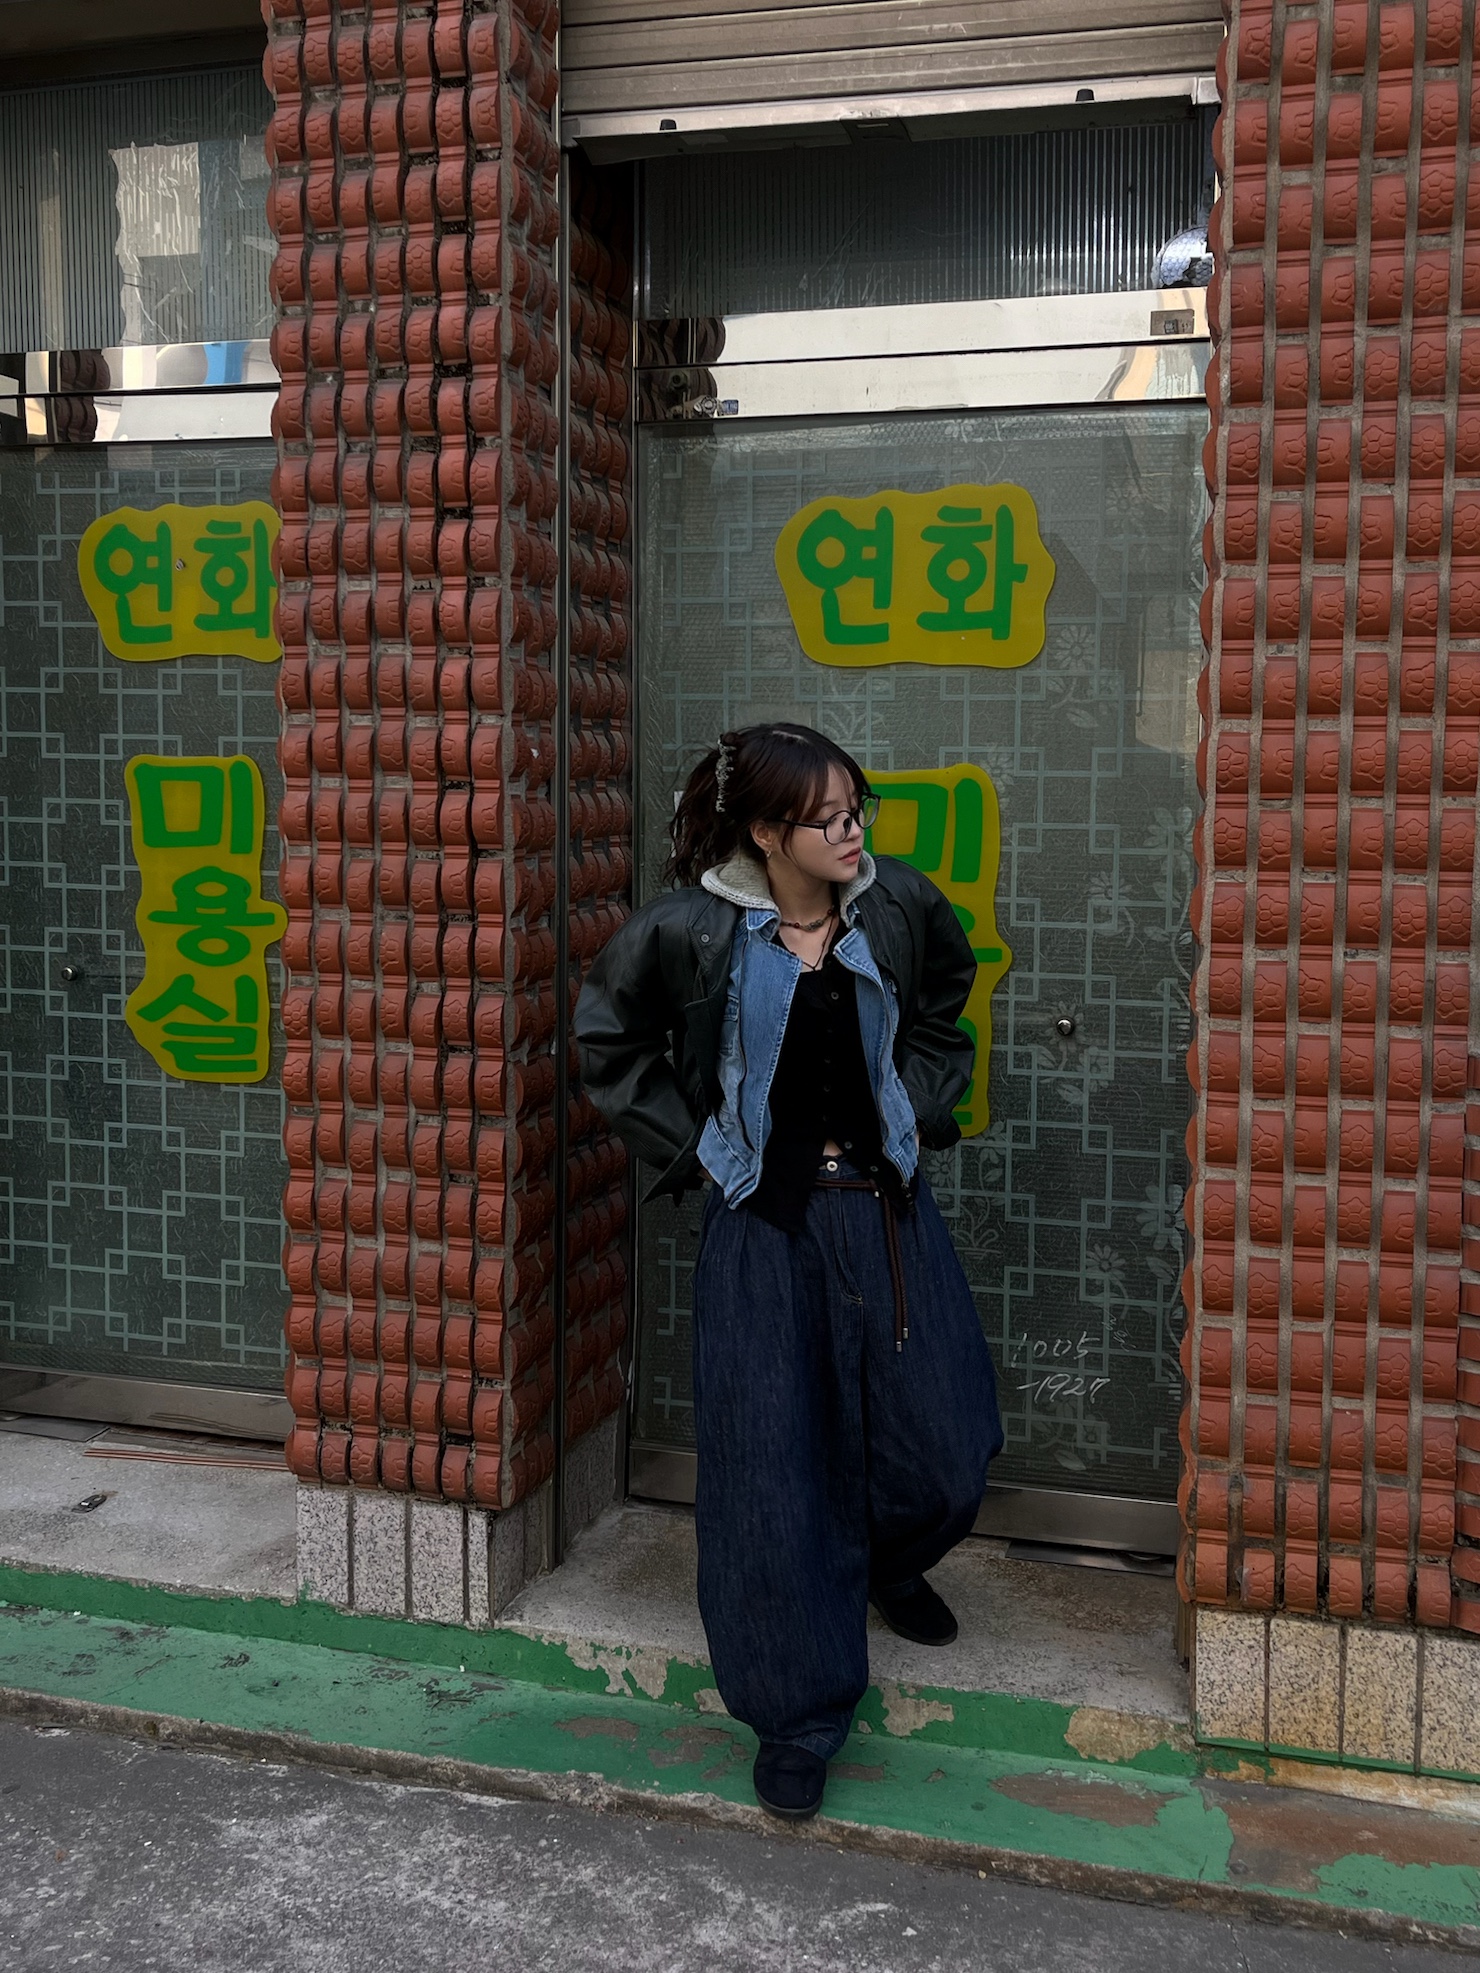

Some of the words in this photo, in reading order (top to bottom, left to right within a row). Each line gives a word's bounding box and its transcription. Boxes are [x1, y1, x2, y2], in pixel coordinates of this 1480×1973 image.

[94, 518, 278, 644] 연화
[796, 504, 1029, 645] 연화
[134, 760, 275, 1073] 미용실
